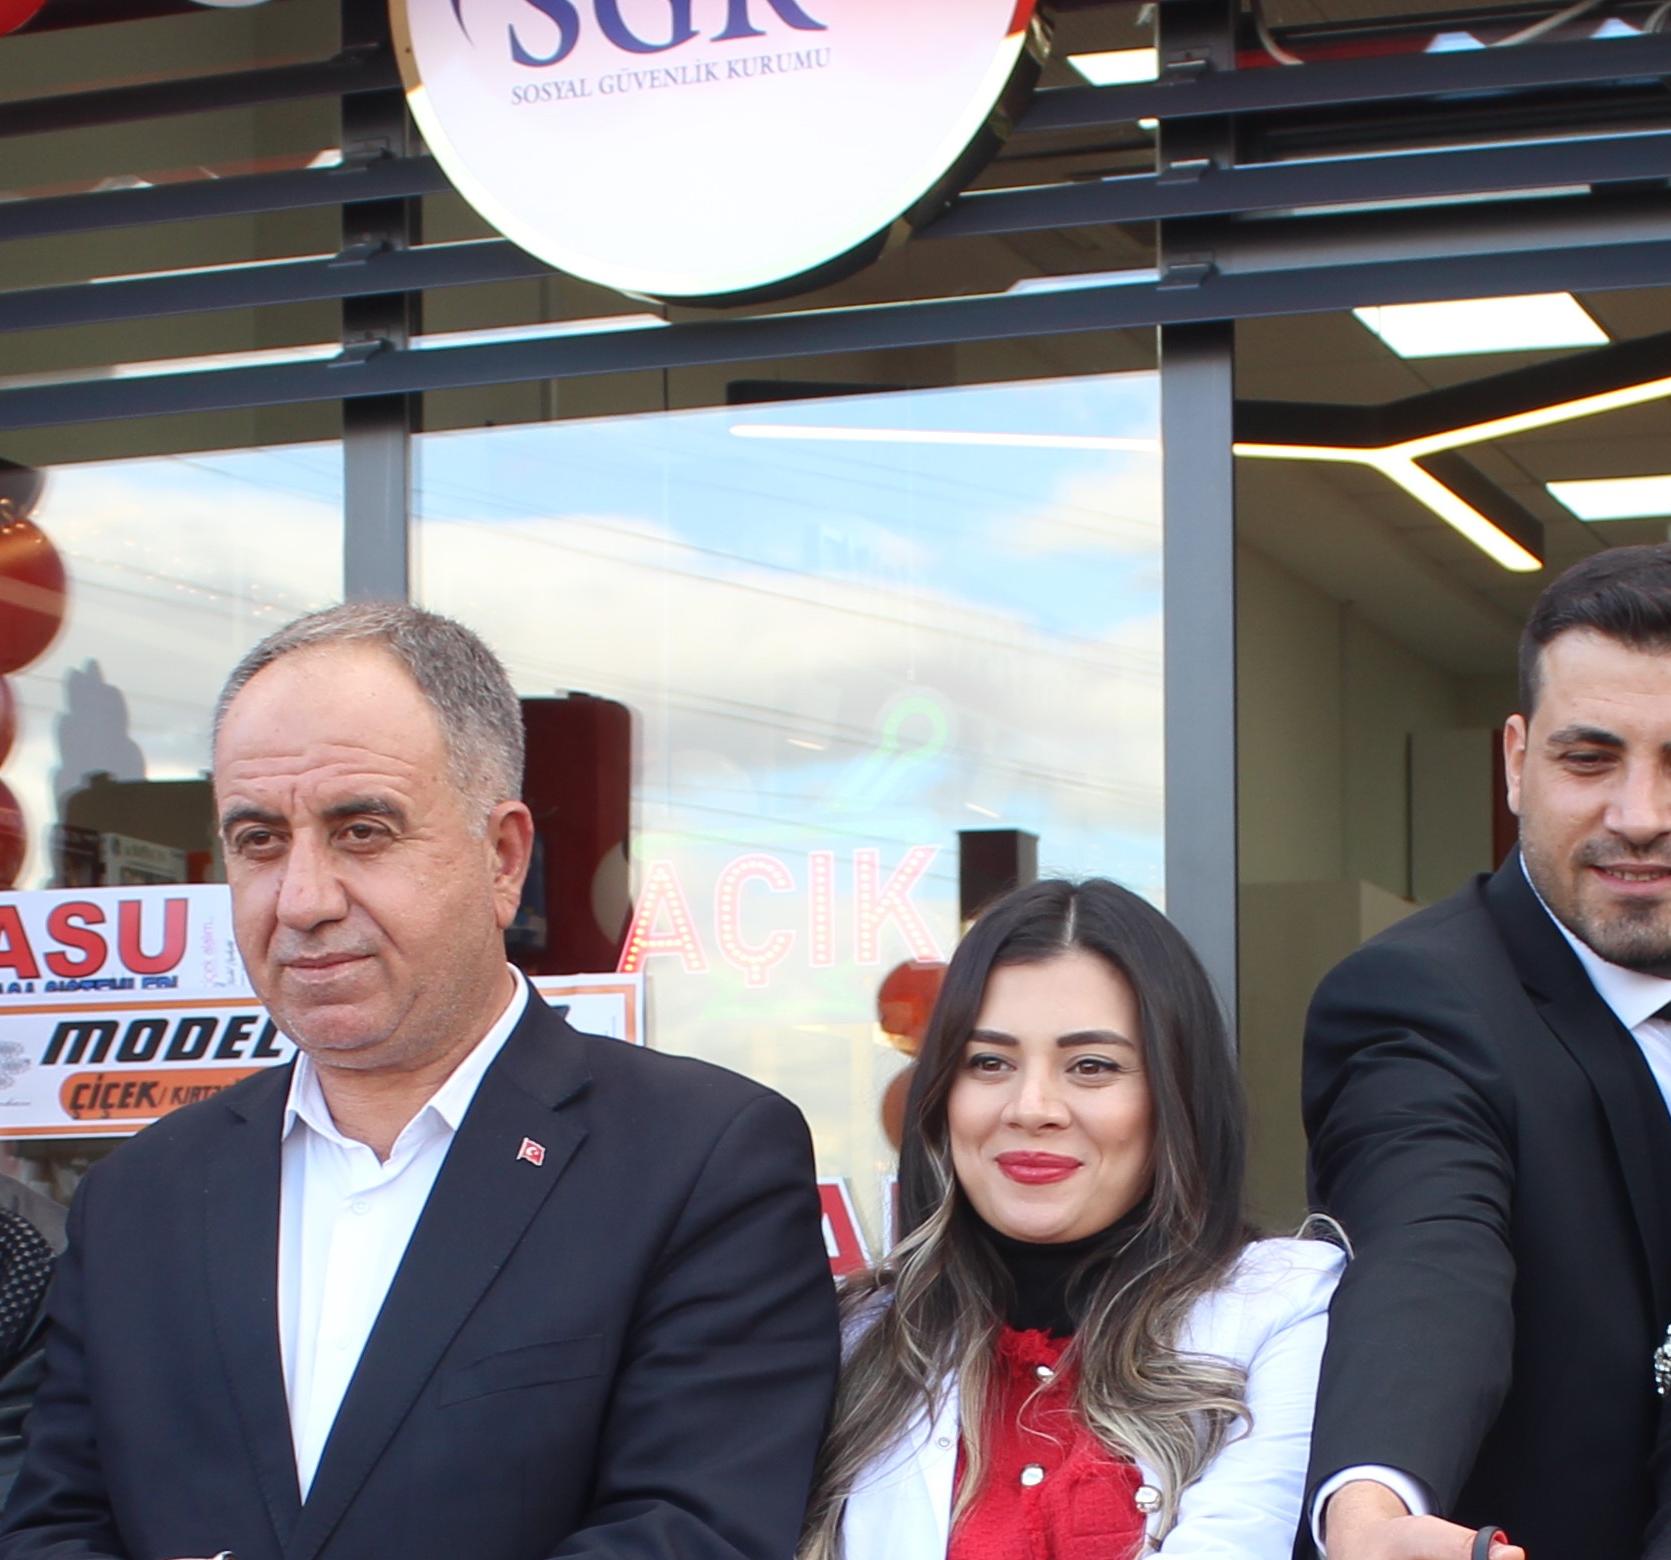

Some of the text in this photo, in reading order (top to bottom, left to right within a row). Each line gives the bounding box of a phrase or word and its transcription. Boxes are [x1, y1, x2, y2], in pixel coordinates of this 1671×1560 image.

[511, 47, 831, 105] SOSYAL GÜVENLİK KURUMU
[617, 845, 944, 987] AÇIK
[40, 1014, 283, 1066] MODEL
[69, 1073, 158, 1120] ÇİÇEK
